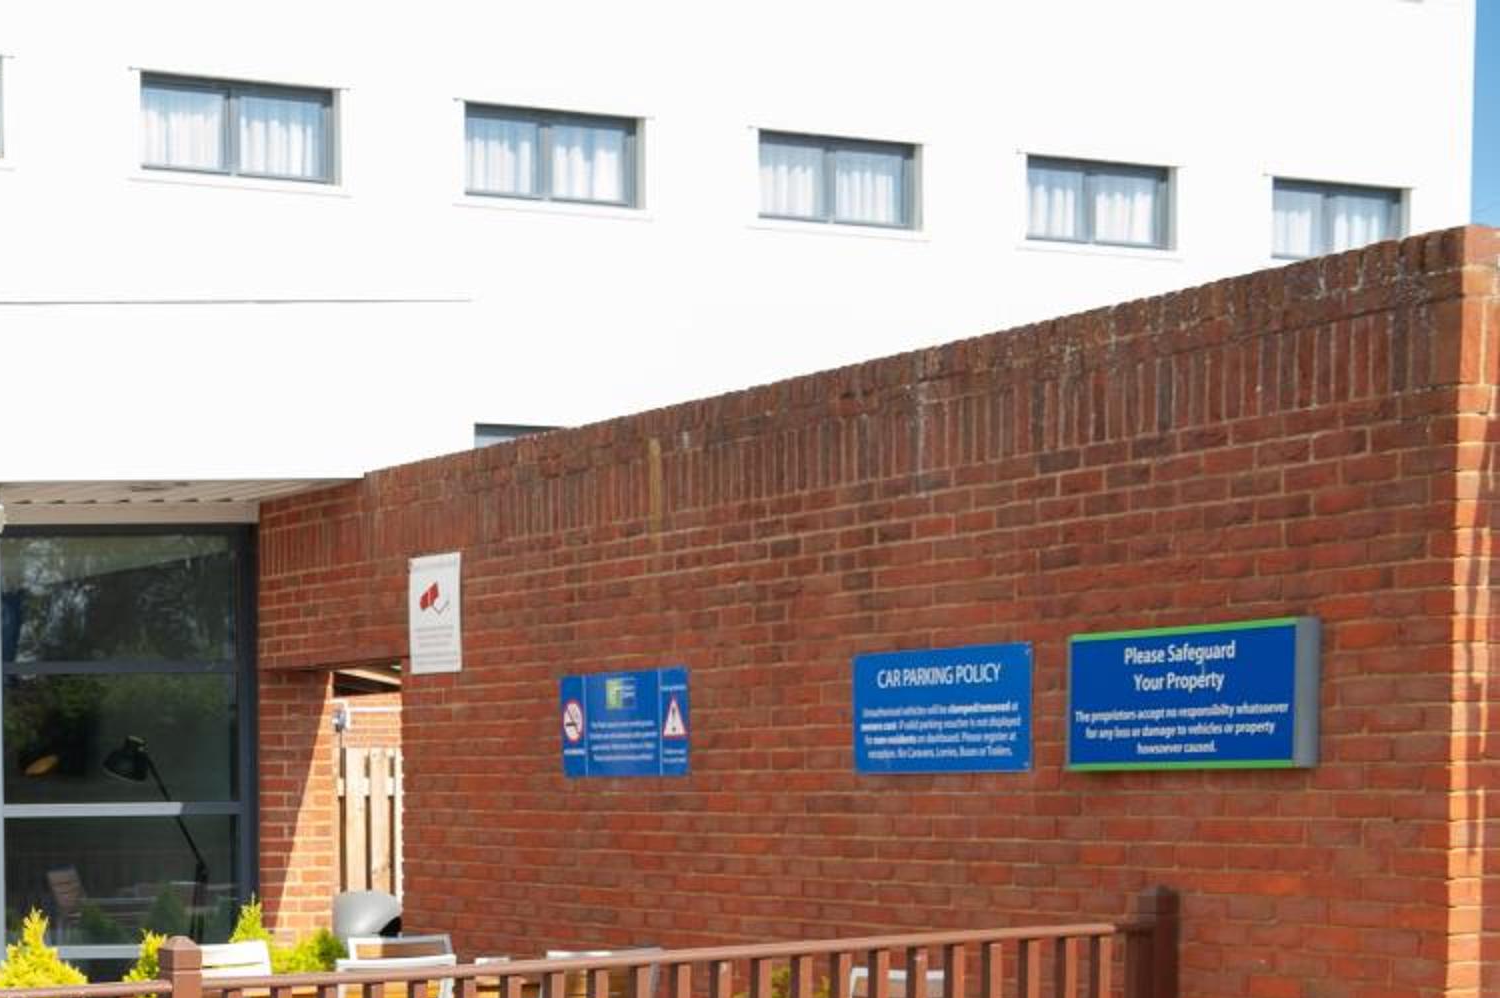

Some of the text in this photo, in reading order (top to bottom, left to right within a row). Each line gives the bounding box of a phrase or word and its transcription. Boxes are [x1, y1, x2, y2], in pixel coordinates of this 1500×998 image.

[1124, 640, 1236, 665] Please Safeguard
[877, 662, 1001, 688] CAR PARKING POLICY
[1134, 671, 1225, 692] Your Property
